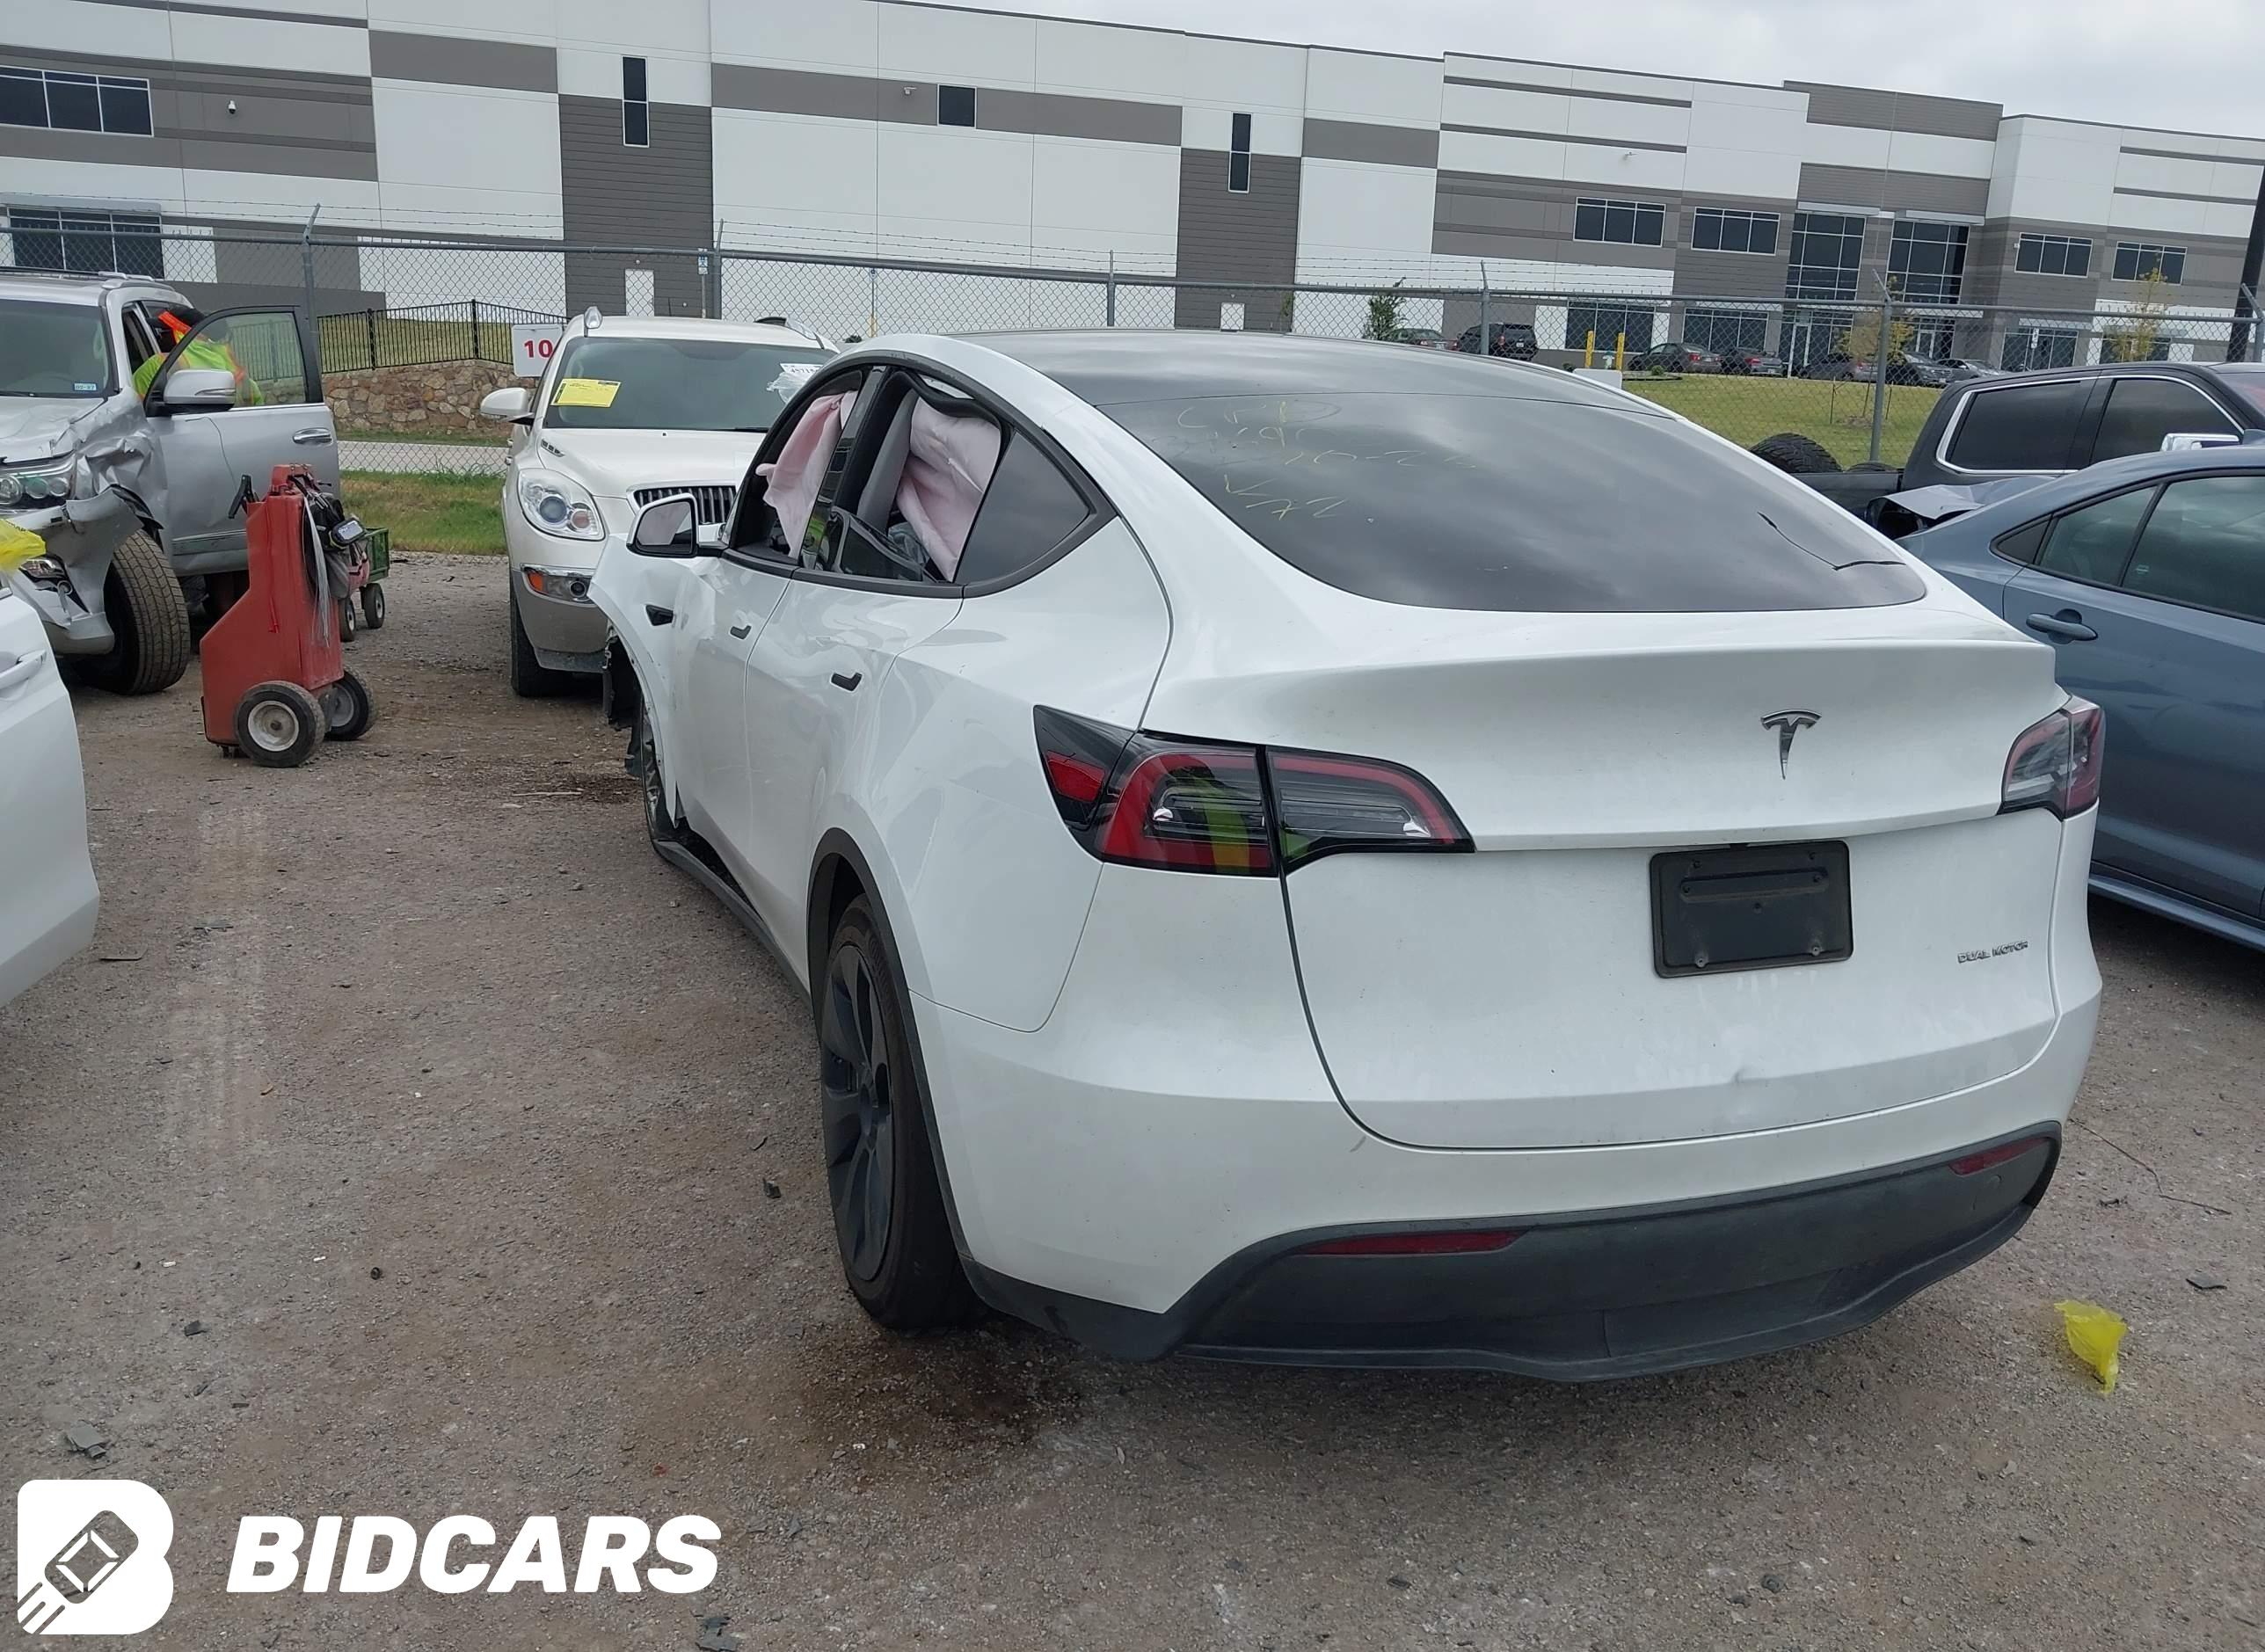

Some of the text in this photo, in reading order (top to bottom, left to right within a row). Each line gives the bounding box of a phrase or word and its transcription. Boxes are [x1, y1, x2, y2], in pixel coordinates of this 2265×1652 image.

[523, 339, 553, 358] 10
[1957, 941, 2028, 964] DUAL MOTOR
